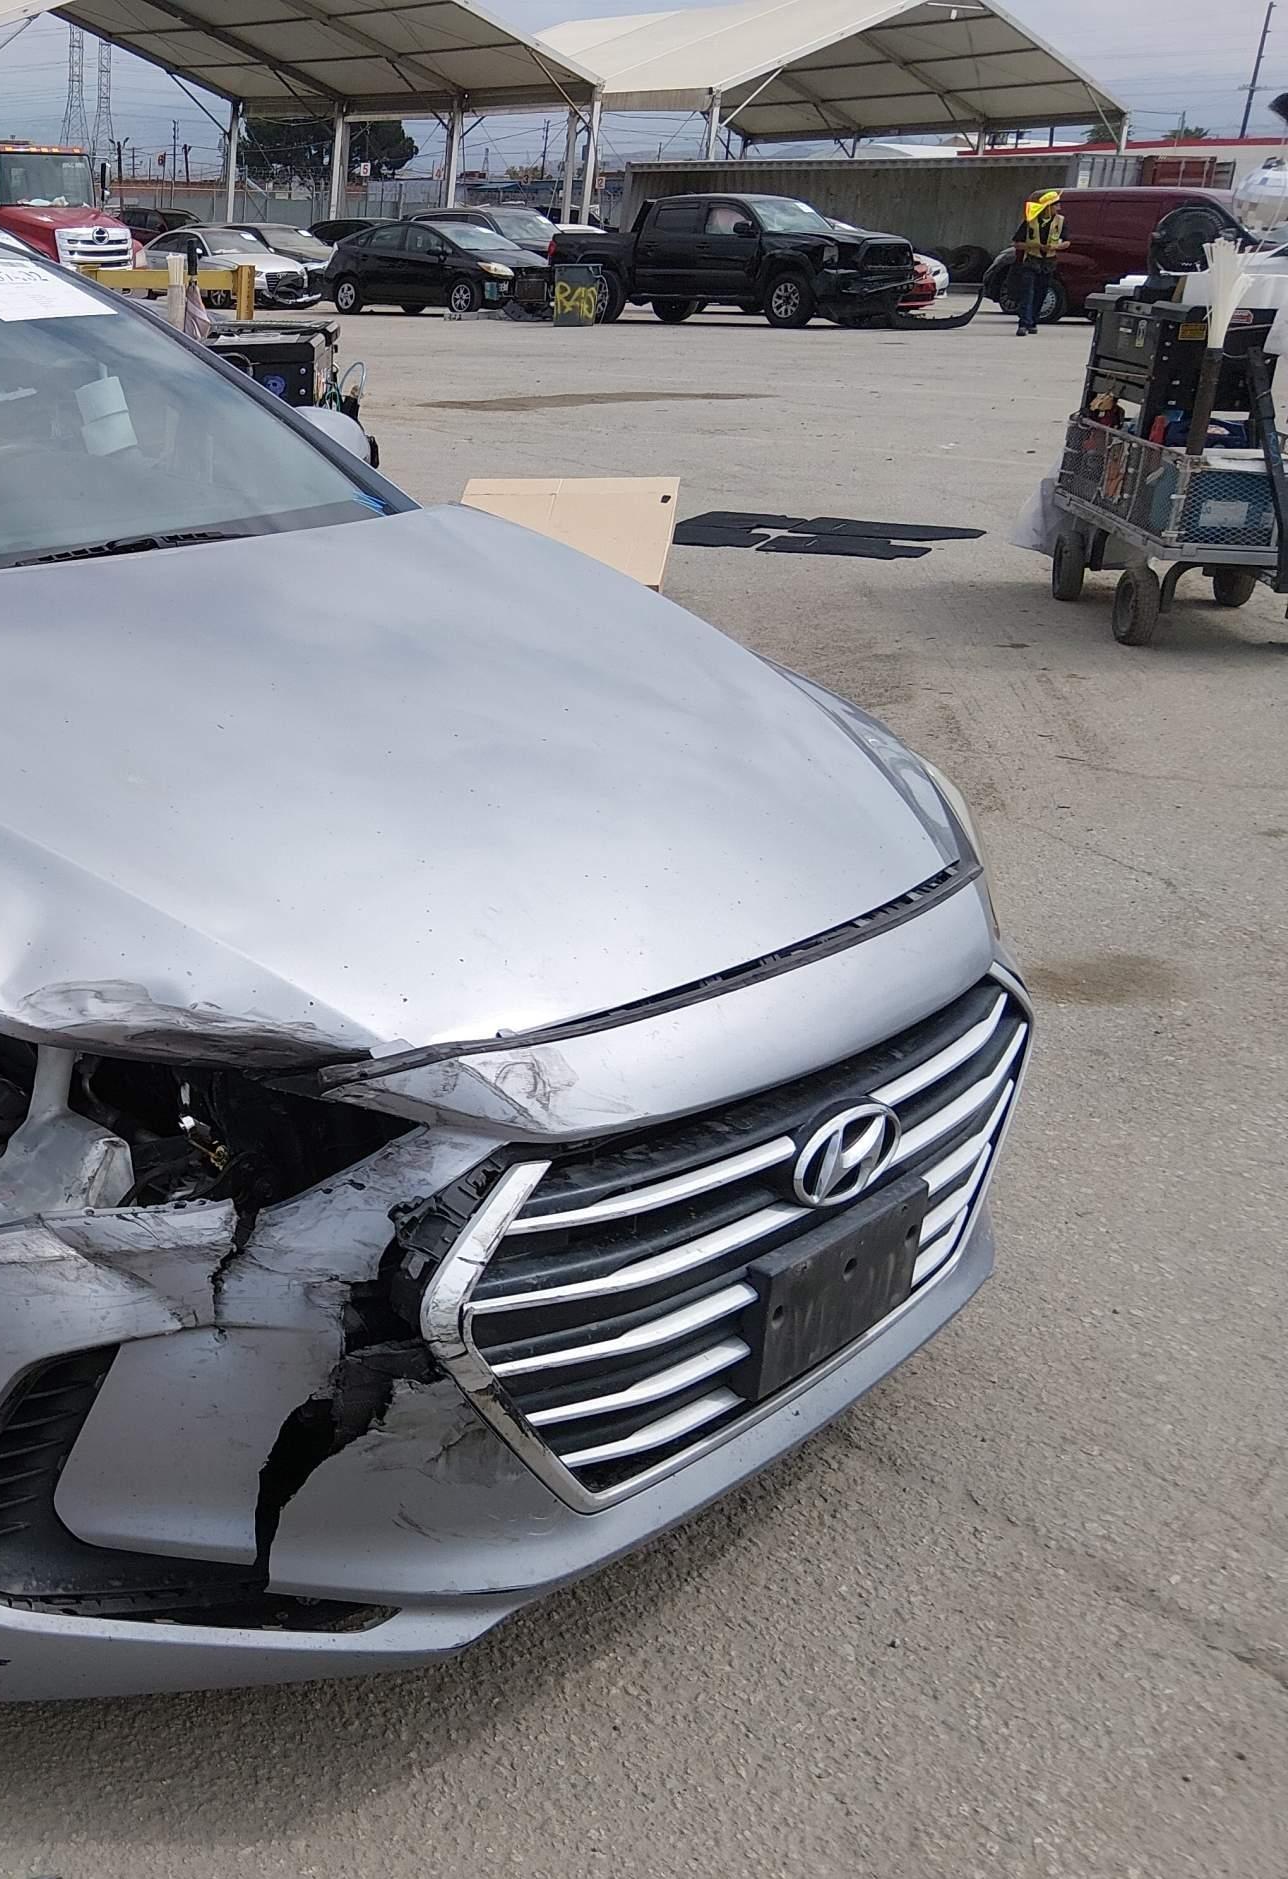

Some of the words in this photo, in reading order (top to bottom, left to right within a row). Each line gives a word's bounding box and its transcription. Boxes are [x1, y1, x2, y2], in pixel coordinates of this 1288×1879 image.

[157, 155, 164, 165] 6
[362, 164, 369, 175] 5
[435, 168, 442, 179] 4
[523, 174, 529, 184] 3
[597, 178, 604, 188] 2
